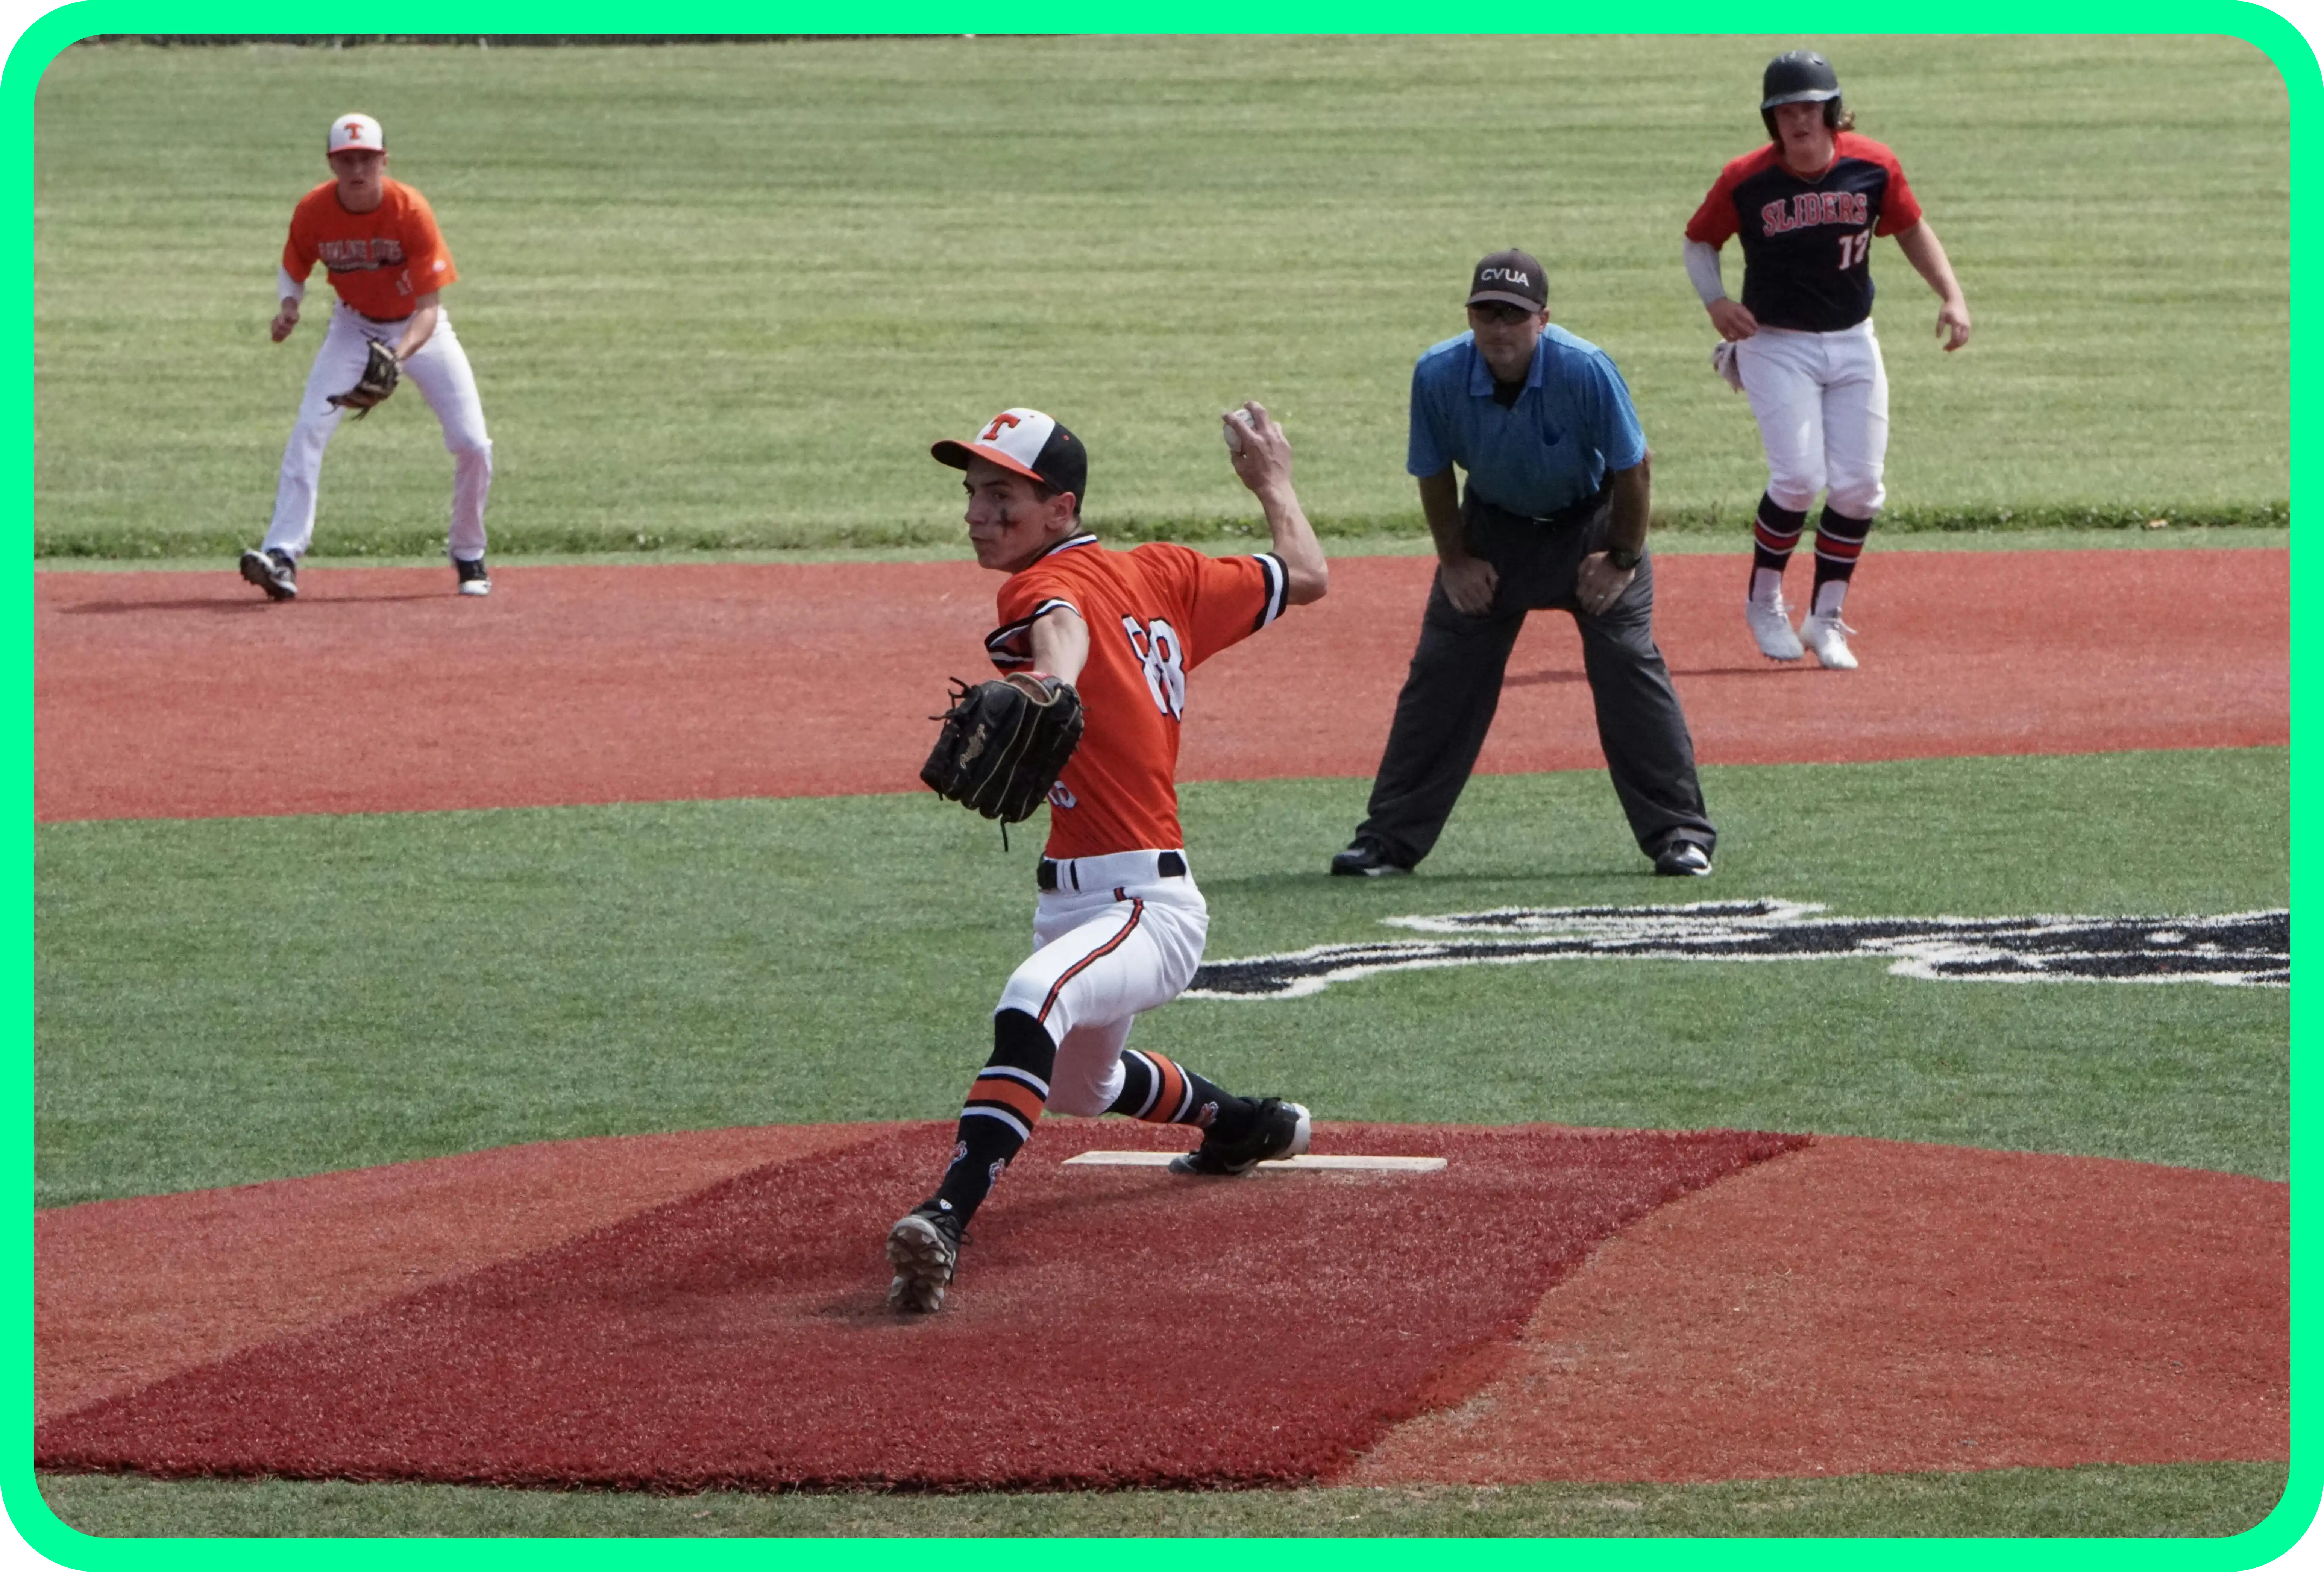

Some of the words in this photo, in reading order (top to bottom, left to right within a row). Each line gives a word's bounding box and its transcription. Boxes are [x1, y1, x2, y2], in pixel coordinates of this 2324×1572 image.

[344, 122, 363, 140] T
[1761, 191, 1867, 237] SLIDERS
[1481, 267, 1530, 288] CVUA
[982, 413, 1021, 440] T
